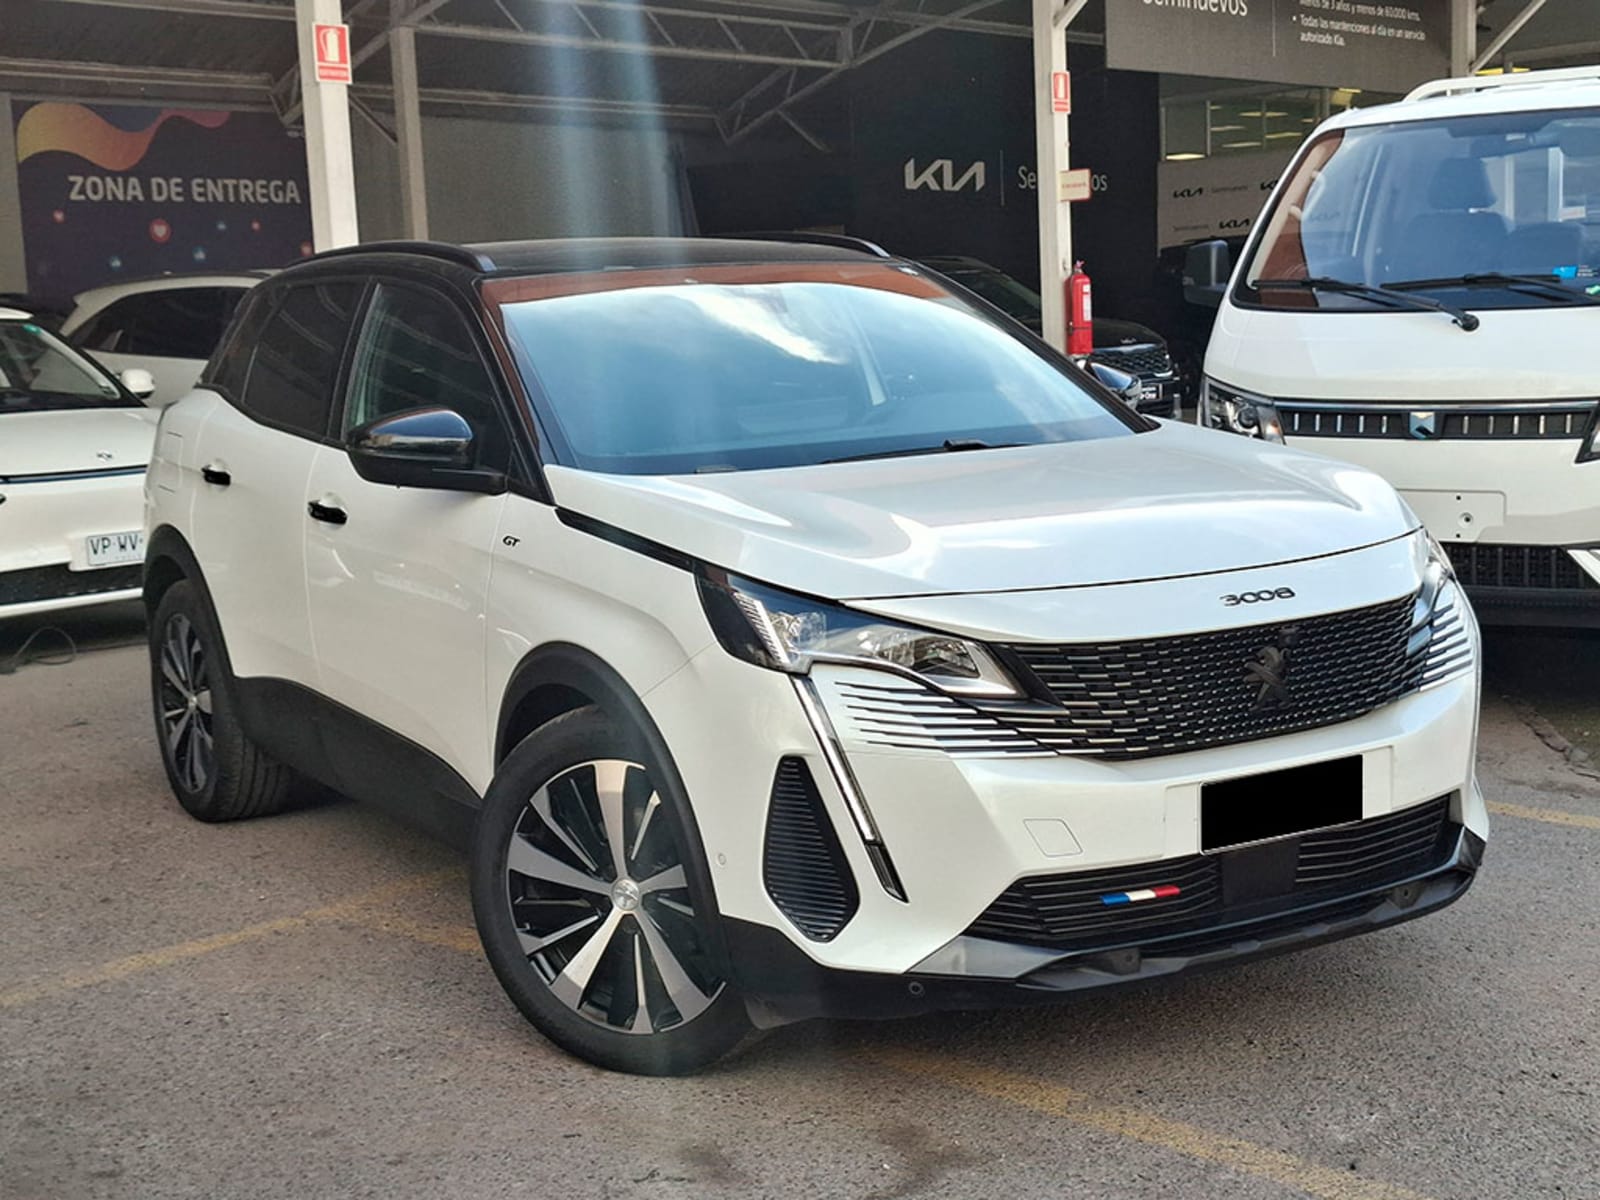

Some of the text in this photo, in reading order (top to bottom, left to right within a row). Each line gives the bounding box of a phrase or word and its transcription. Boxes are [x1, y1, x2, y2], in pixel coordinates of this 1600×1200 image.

[1143, 0, 1248, 16] uevos
[904, 158, 985, 192] KIA
[68, 175, 302, 204] ZONA DE ENTREGA
[1173, 187, 1204, 198] KIA
[1219, 218, 1250, 229] KIA
[502, 535, 521, 547] GT
[1219, 587, 1295, 607] 3008
